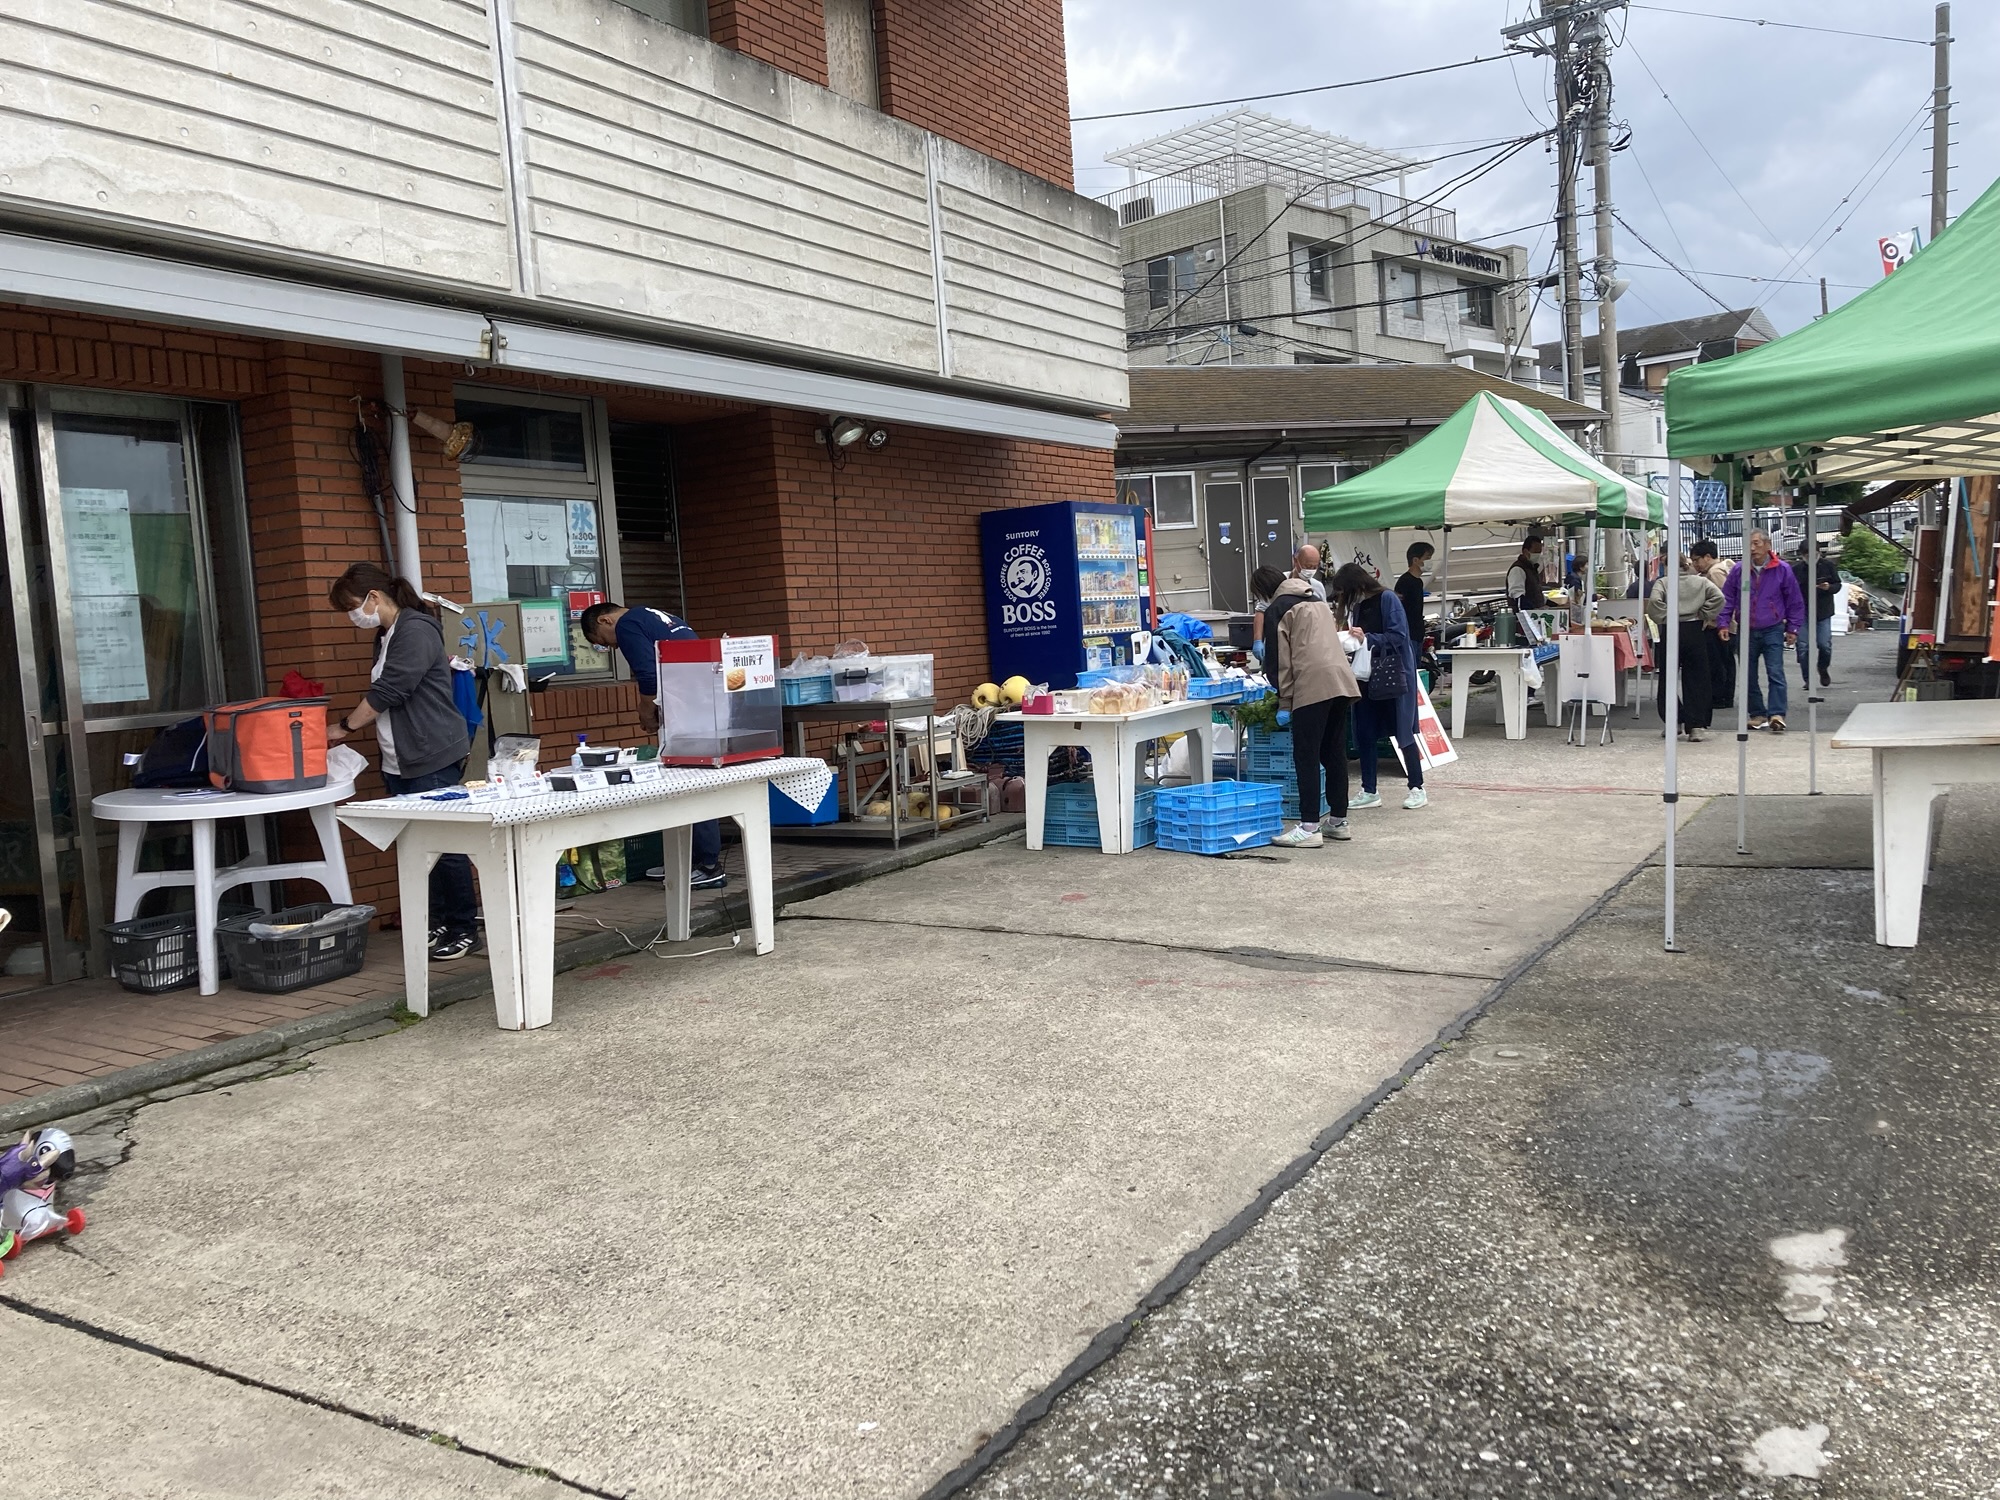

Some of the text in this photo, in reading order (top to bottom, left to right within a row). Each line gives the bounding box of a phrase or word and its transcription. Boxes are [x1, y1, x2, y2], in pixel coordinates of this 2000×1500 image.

[1455, 250, 1501, 273] UNIVERSITY
[571, 503, 594, 532] 氷
[1004, 543, 1045, 562] COFFEE
[1001, 600, 1056, 625] BOSS
[459, 611, 511, 668] 氷
